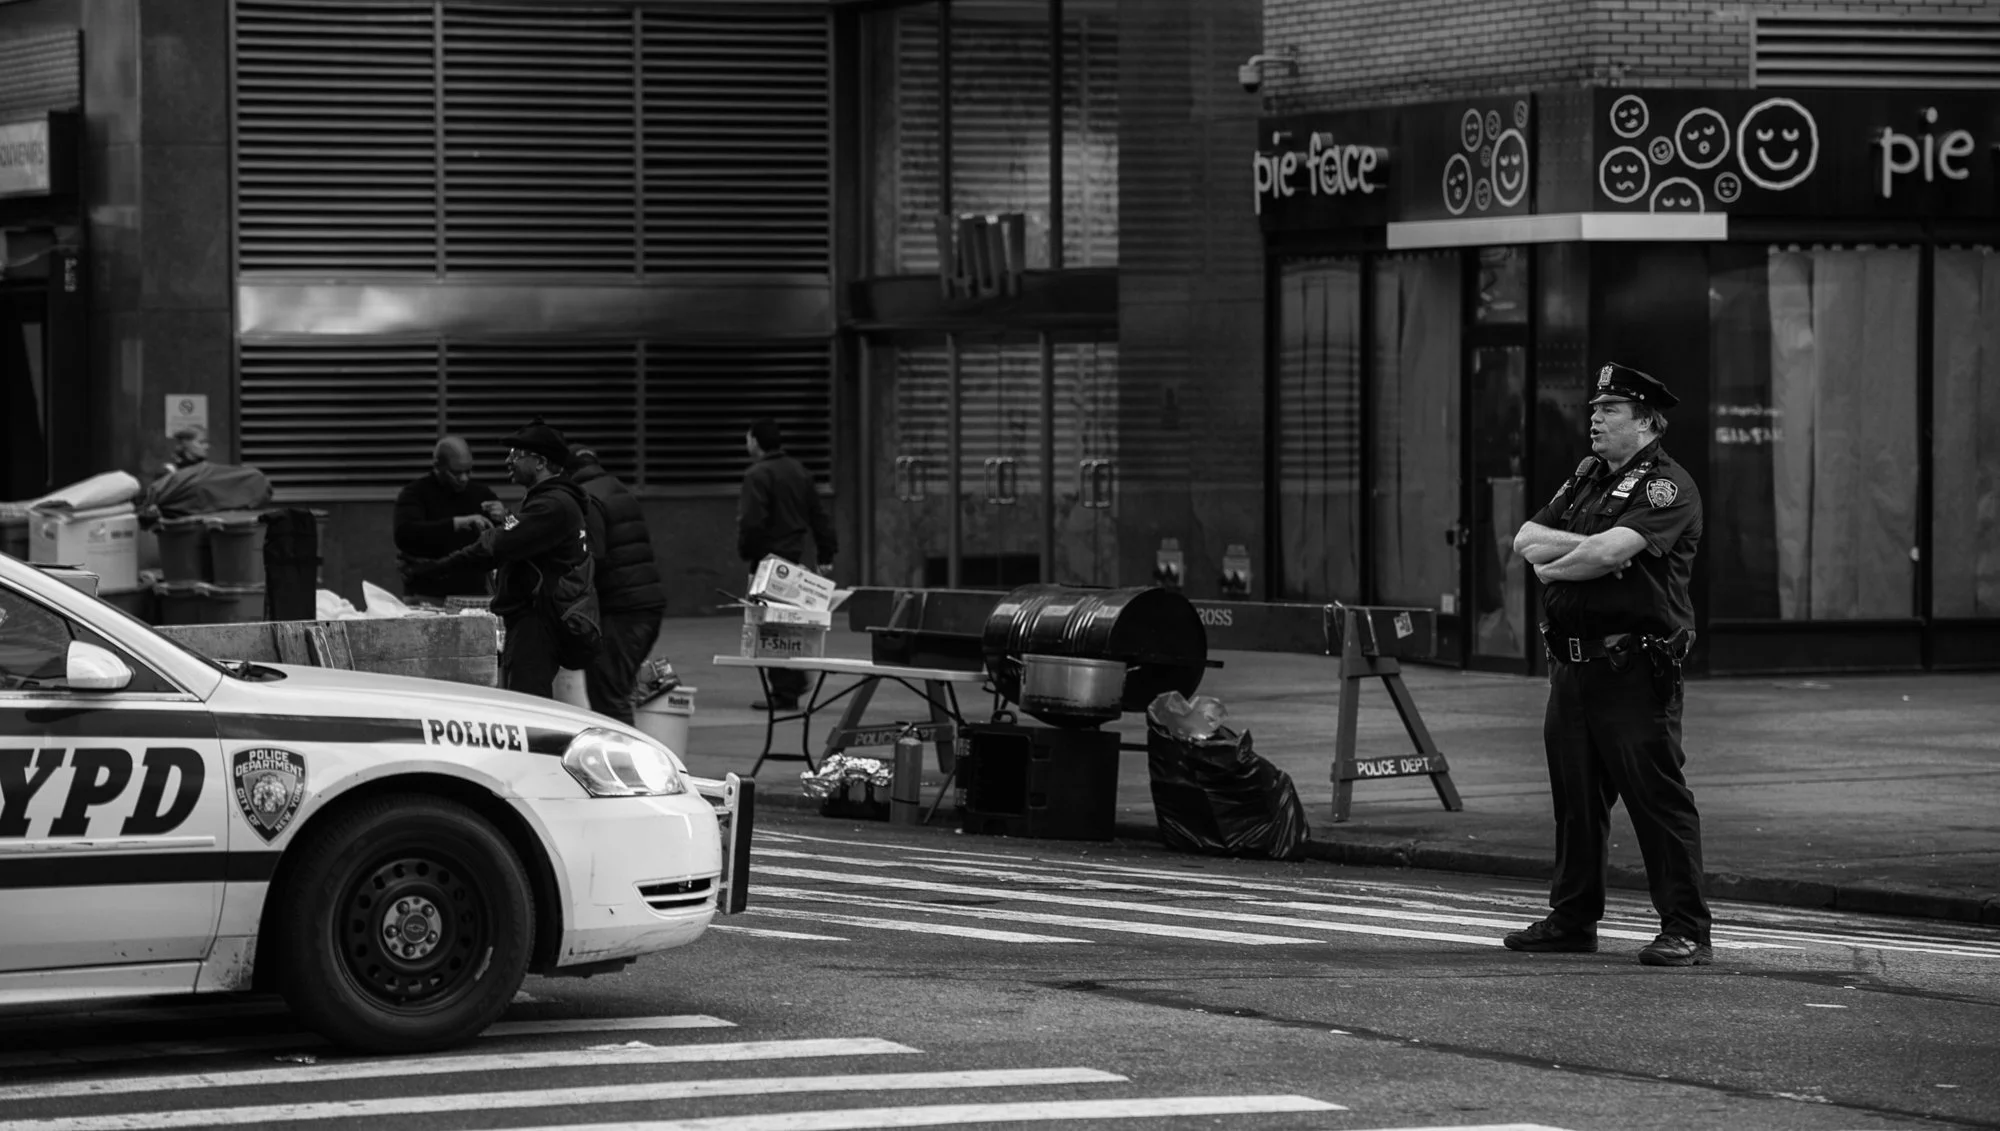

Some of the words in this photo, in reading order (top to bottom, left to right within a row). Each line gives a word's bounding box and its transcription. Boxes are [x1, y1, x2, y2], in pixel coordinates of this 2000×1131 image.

[1880, 106, 1975, 199] pie
[1253, 130, 1297, 216] pie
[1305, 130, 1377, 196] face
[759, 636, 802, 651] T-Shirt
[427, 719, 522, 752] POLICE
[235, 759, 303, 778] DEPARTMENT
[248, 749, 290, 763] POLICE
[1356, 759, 1397, 776] POLICE
[1400, 757, 1433, 774] DEPT.
[236, 787, 251, 812] CITY
[248, 813, 261, 827] OF
[274, 810, 292, 833] NEW
[289, 782, 304, 809] YORK
